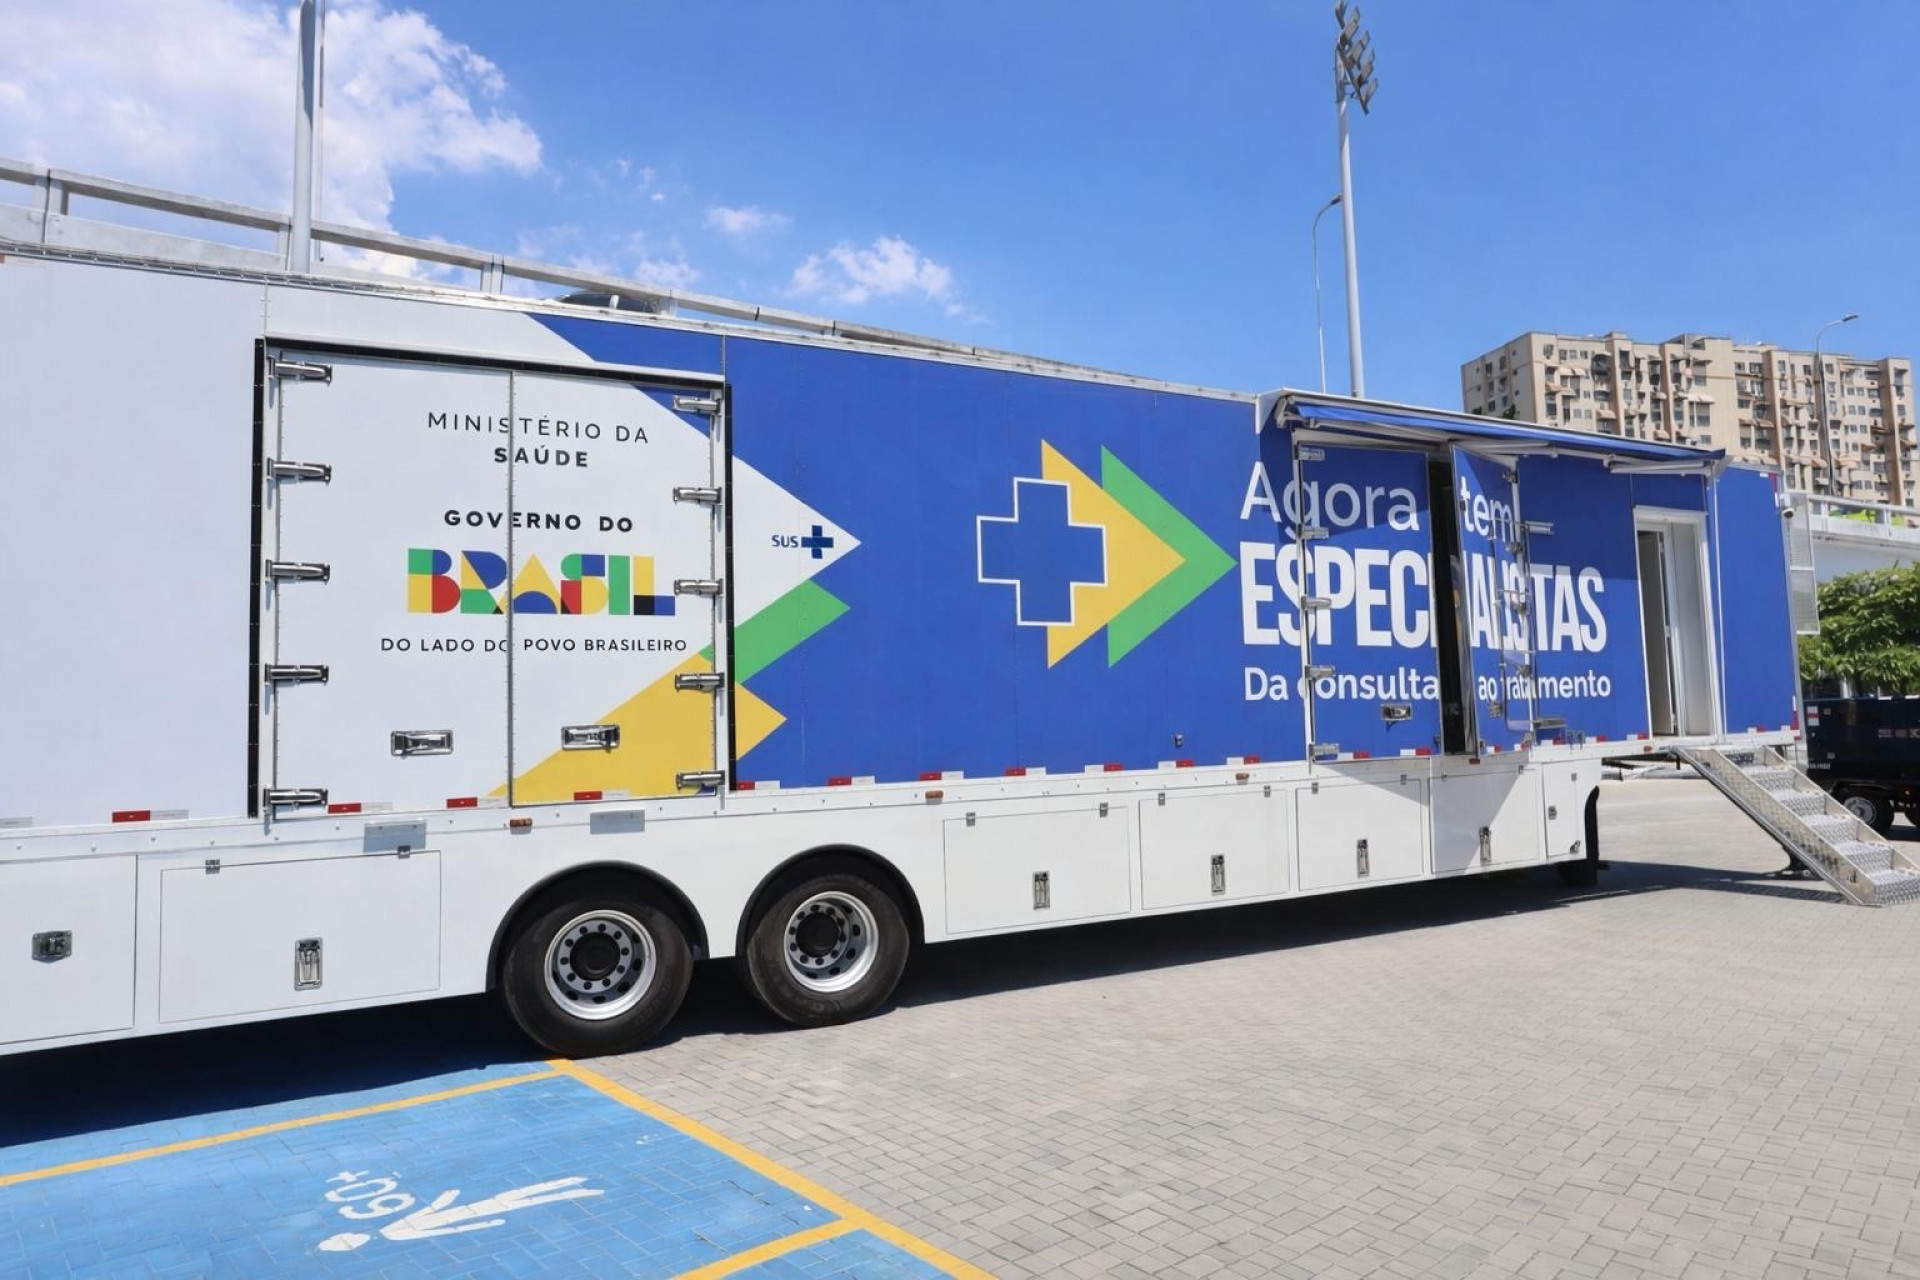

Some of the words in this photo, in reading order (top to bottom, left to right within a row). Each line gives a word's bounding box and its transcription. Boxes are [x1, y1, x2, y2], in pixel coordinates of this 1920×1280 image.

[428, 411, 601, 439] MINISTÉRIO
[615, 425, 649, 444] DA
[494, 445, 588, 467] SAÚDE
[1240, 460, 1420, 540] Agora
[1461, 475, 1516, 542] tem
[444, 509, 581, 530] GOVERNO
[600, 516, 633, 532] DO
[771, 534, 799, 548] SUS
[407, 548, 676, 616] BRASIL
[381, 638, 411, 651] DO
[420, 638, 475, 652] LADO
[524, 638, 576, 652] POVO
[584, 638, 687, 652] BRASILEIRO
[1244, 667, 1289, 701] Da
[1478, 675, 1498, 701] ao
